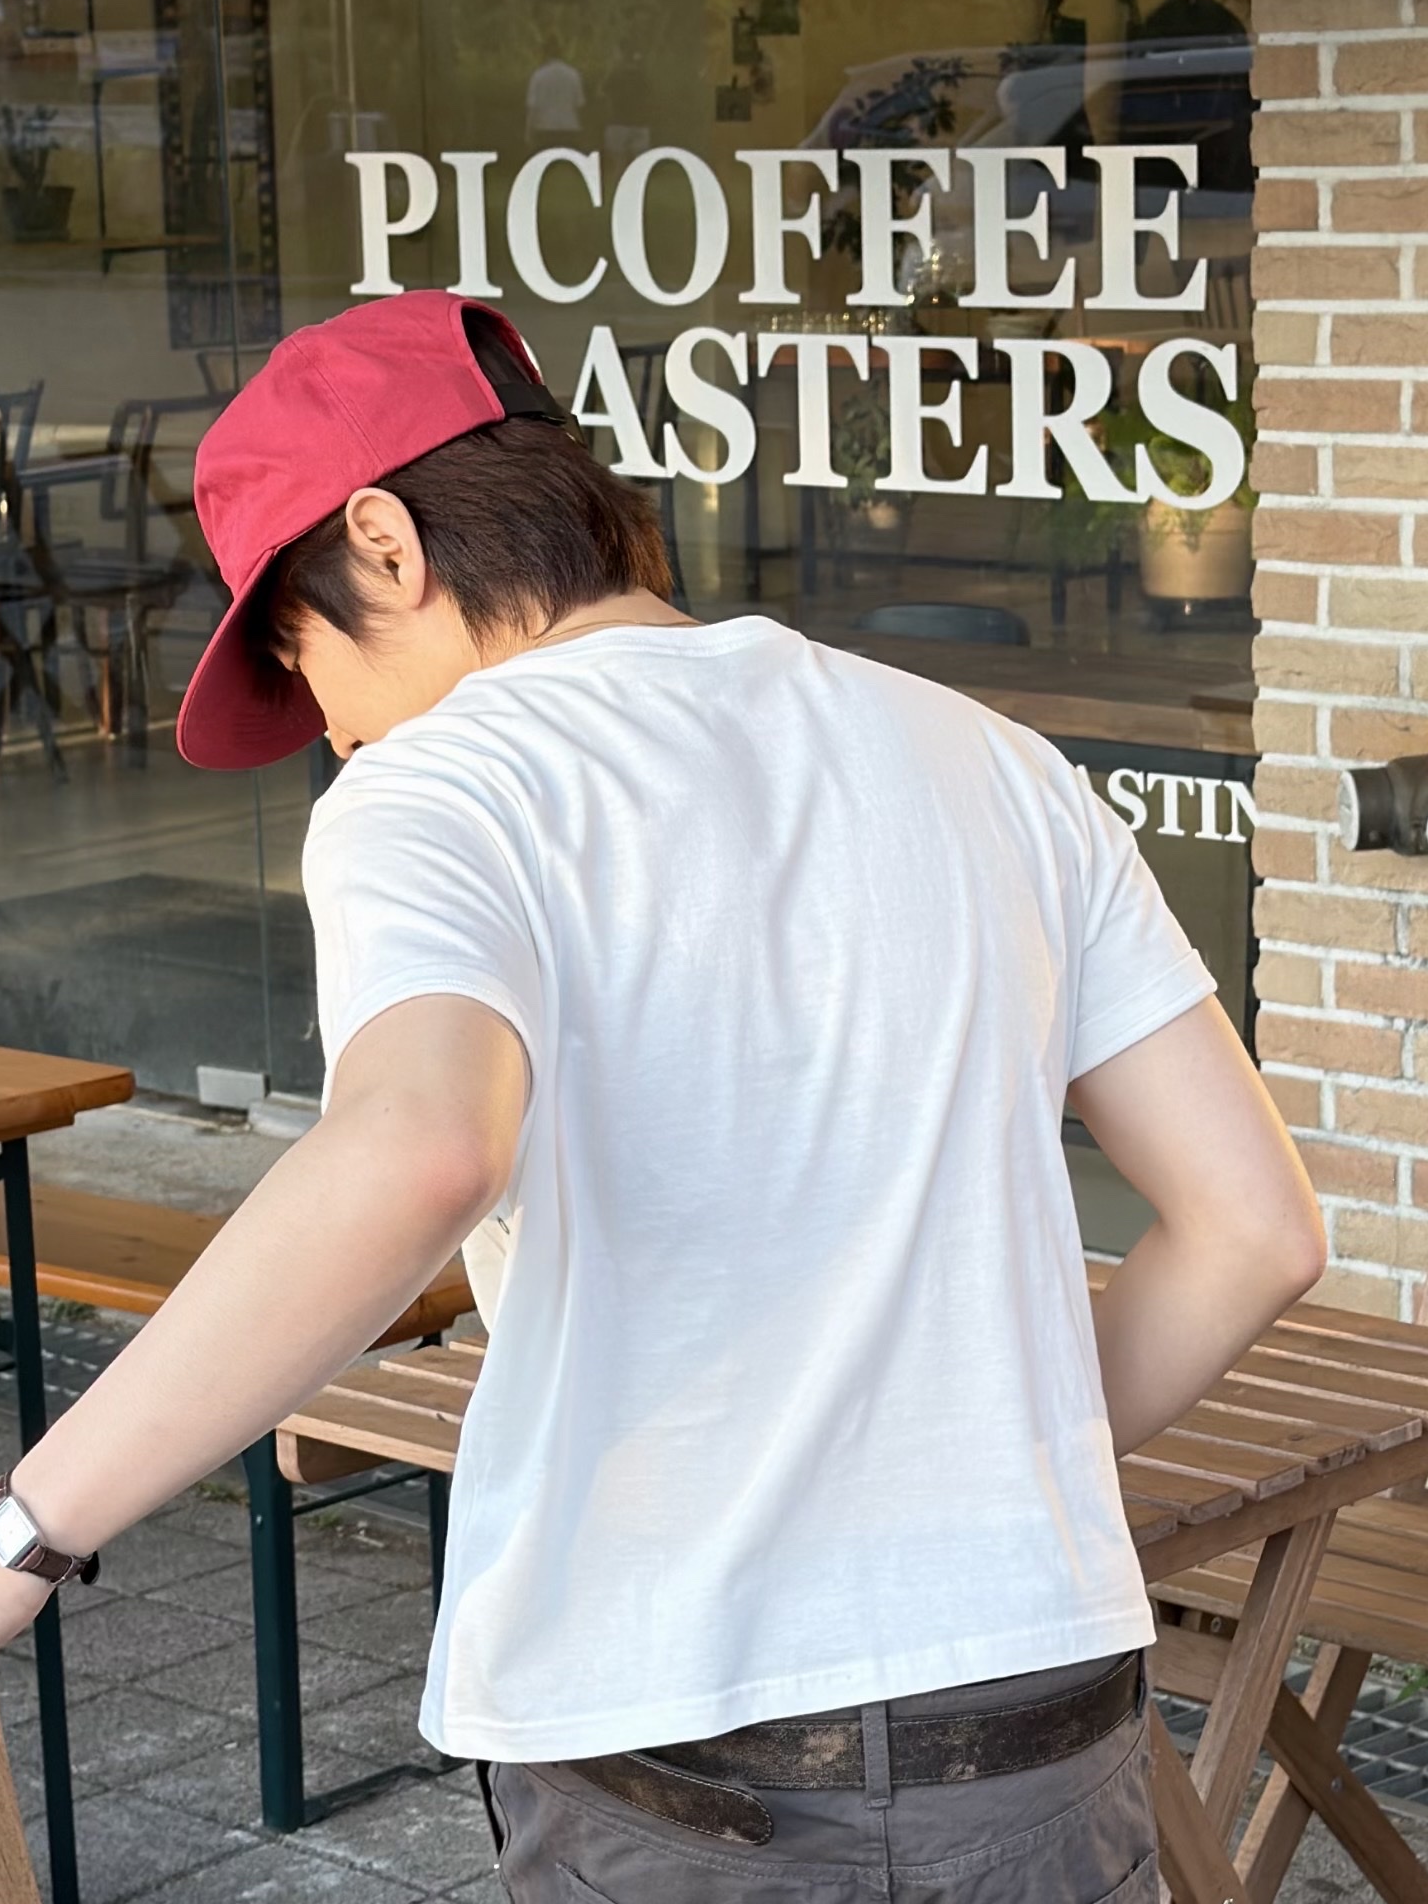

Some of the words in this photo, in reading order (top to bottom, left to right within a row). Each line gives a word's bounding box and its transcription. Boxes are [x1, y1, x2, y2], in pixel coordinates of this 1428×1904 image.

[345, 146, 1208, 312] PICOFFEE
[522, 324, 1247, 510] ASTERS
[1075, 765, 1259, 844] STIN
